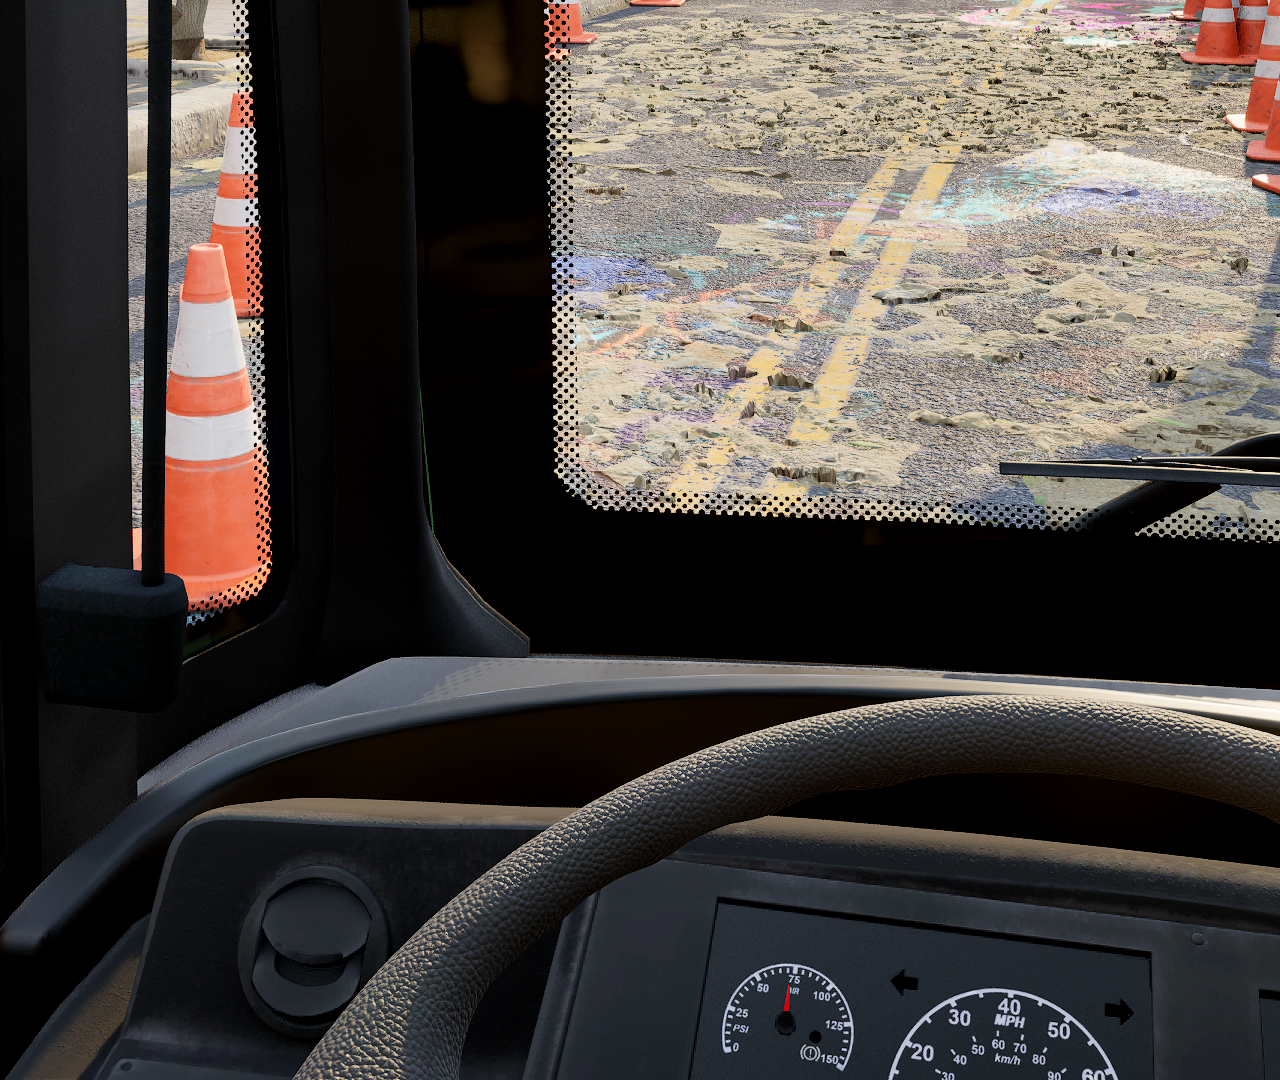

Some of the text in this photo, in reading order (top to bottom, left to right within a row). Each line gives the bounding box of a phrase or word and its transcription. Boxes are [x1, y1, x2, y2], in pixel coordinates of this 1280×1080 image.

[788, 975, 801, 984] 75
[757, 983, 770, 993] 50
[813, 991, 831, 1002] 100
[735, 1007, 749, 1018] 25
[997, 998, 1021, 1016] 40
[948, 1008, 971, 1027] 30
[994, 1013, 1026, 1029] MPH
[733, 1024, 749, 1033] PSI
[825, 1020, 843, 1031] 125
[1047, 1021, 1071, 1040] 50
[733, 1042, 739, 1052] 0
[971, 1044, 985, 1056] 50
[991, 1039, 1006, 1050] 60
[1013, 1042, 1027, 1054] 70
[911, 1043, 935, 1062] 20
[820, 1053, 839, 1065] 150
[953, 1054, 967, 1066] 40
[994, 1052, 1021, 1066] km/h
[1032, 1054, 1046, 1066] 80
[941, 1071, 955, 1080] 30
[1047, 1071, 1062, 1080] 90
